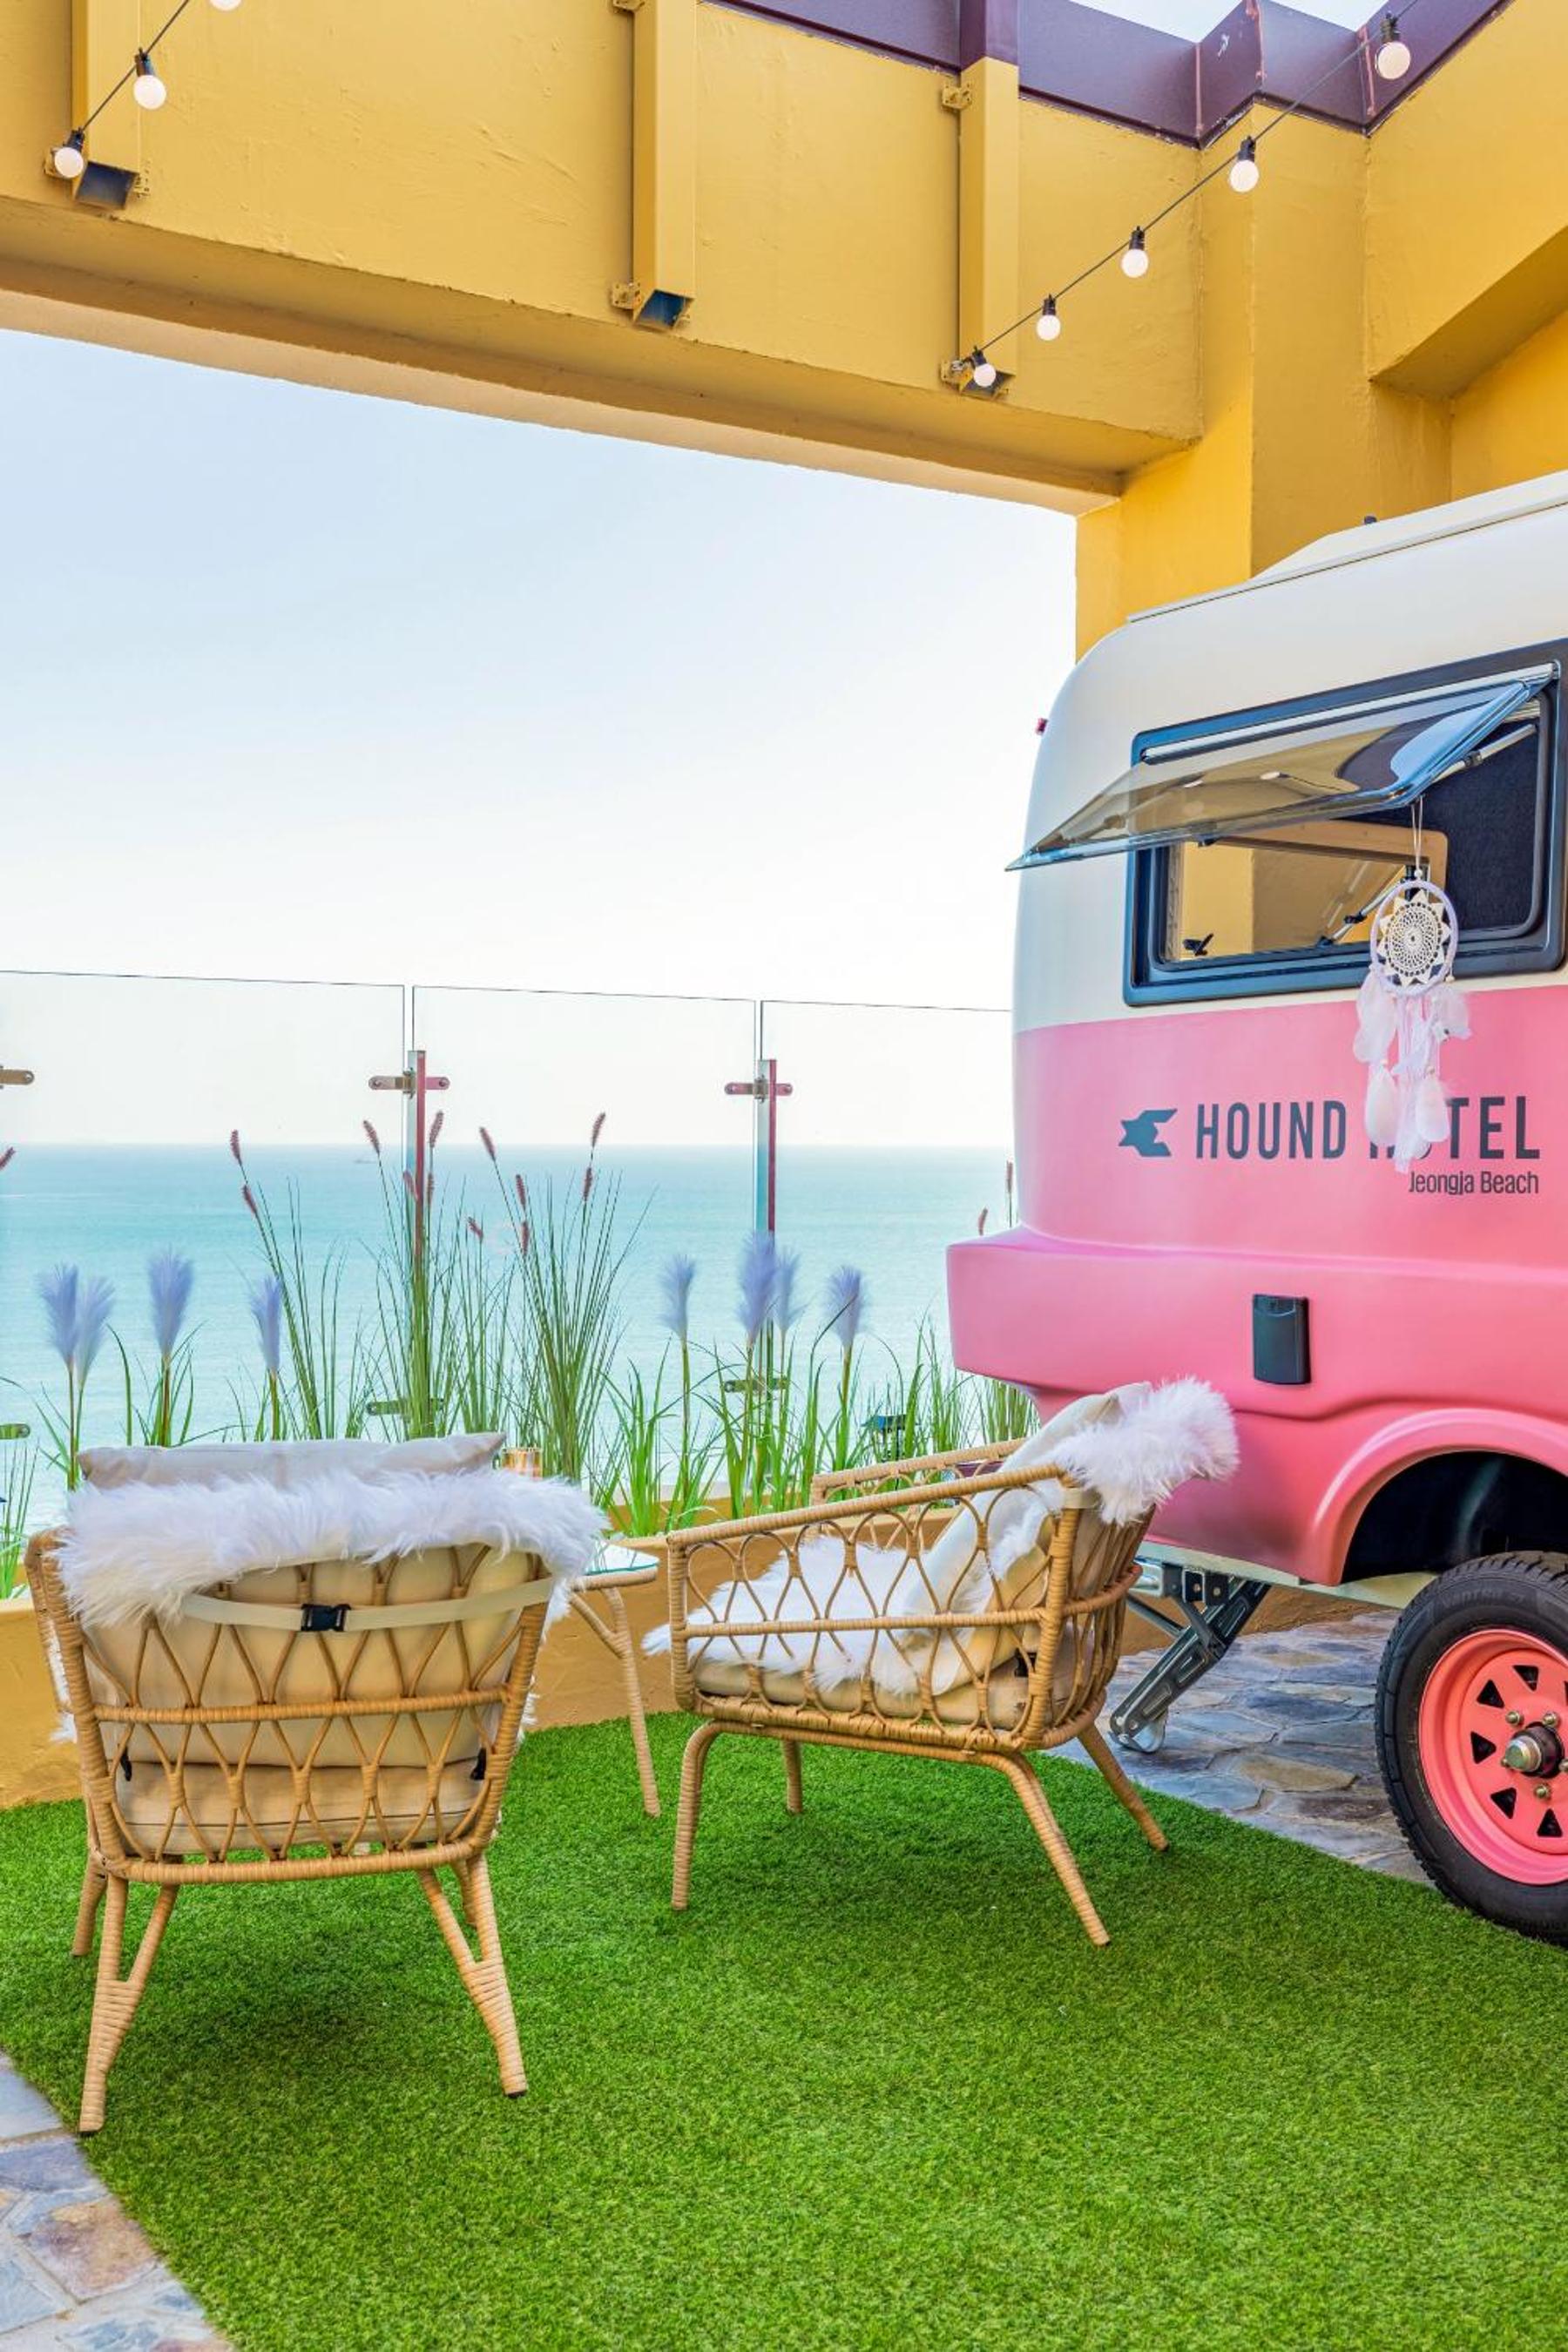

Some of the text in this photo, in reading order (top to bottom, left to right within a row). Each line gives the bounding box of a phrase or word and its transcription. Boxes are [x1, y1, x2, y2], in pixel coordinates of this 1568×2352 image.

[1196, 1096, 1540, 1159] HOUND TEL
[1409, 1171, 1539, 1196] Jeongja Beach
